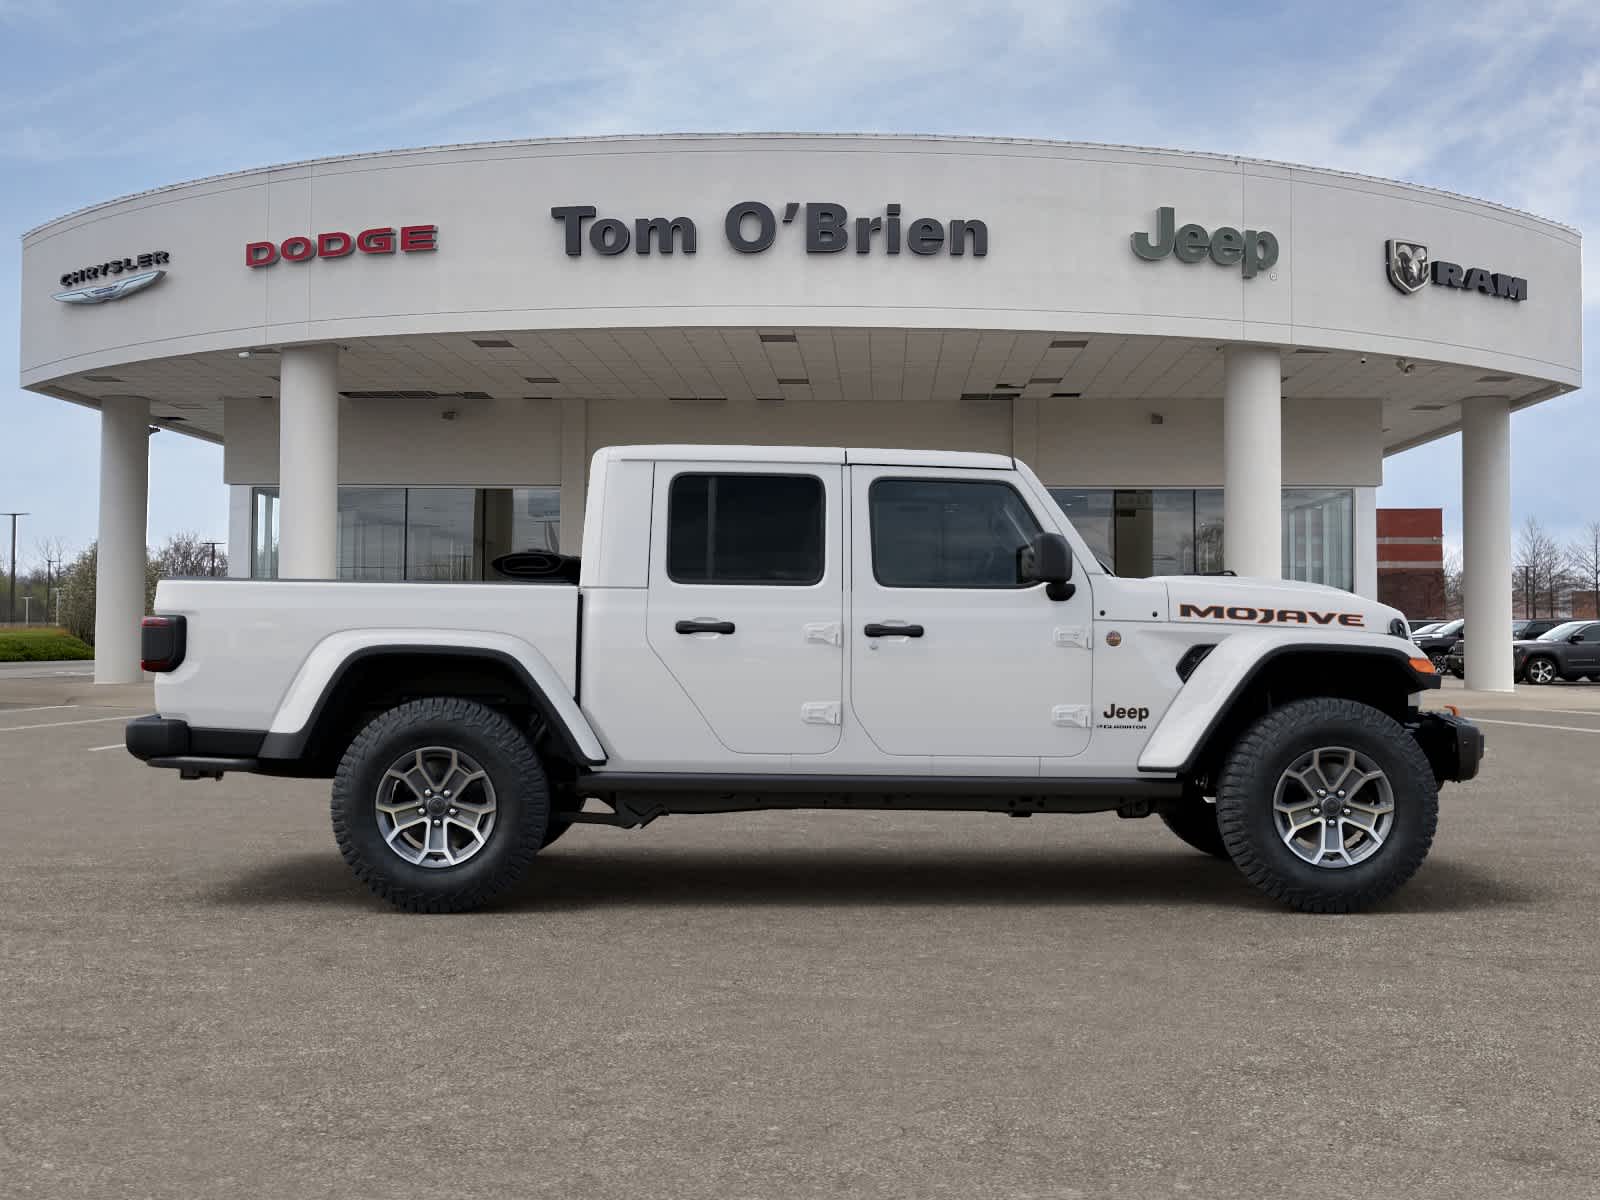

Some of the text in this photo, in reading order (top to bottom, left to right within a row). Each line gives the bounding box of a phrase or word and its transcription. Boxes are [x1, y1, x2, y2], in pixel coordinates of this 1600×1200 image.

[245, 224, 438, 269] DODGE
[551, 201, 989, 257] Tom O'Brien
[1130, 206, 1280, 279] Jeep
[60, 250, 170, 288] CHRYSLER
[1431, 260, 1528, 302] RAM
[1179, 603, 1365, 628] MOJAVE
[1103, 703, 1149, 721] Jeep
